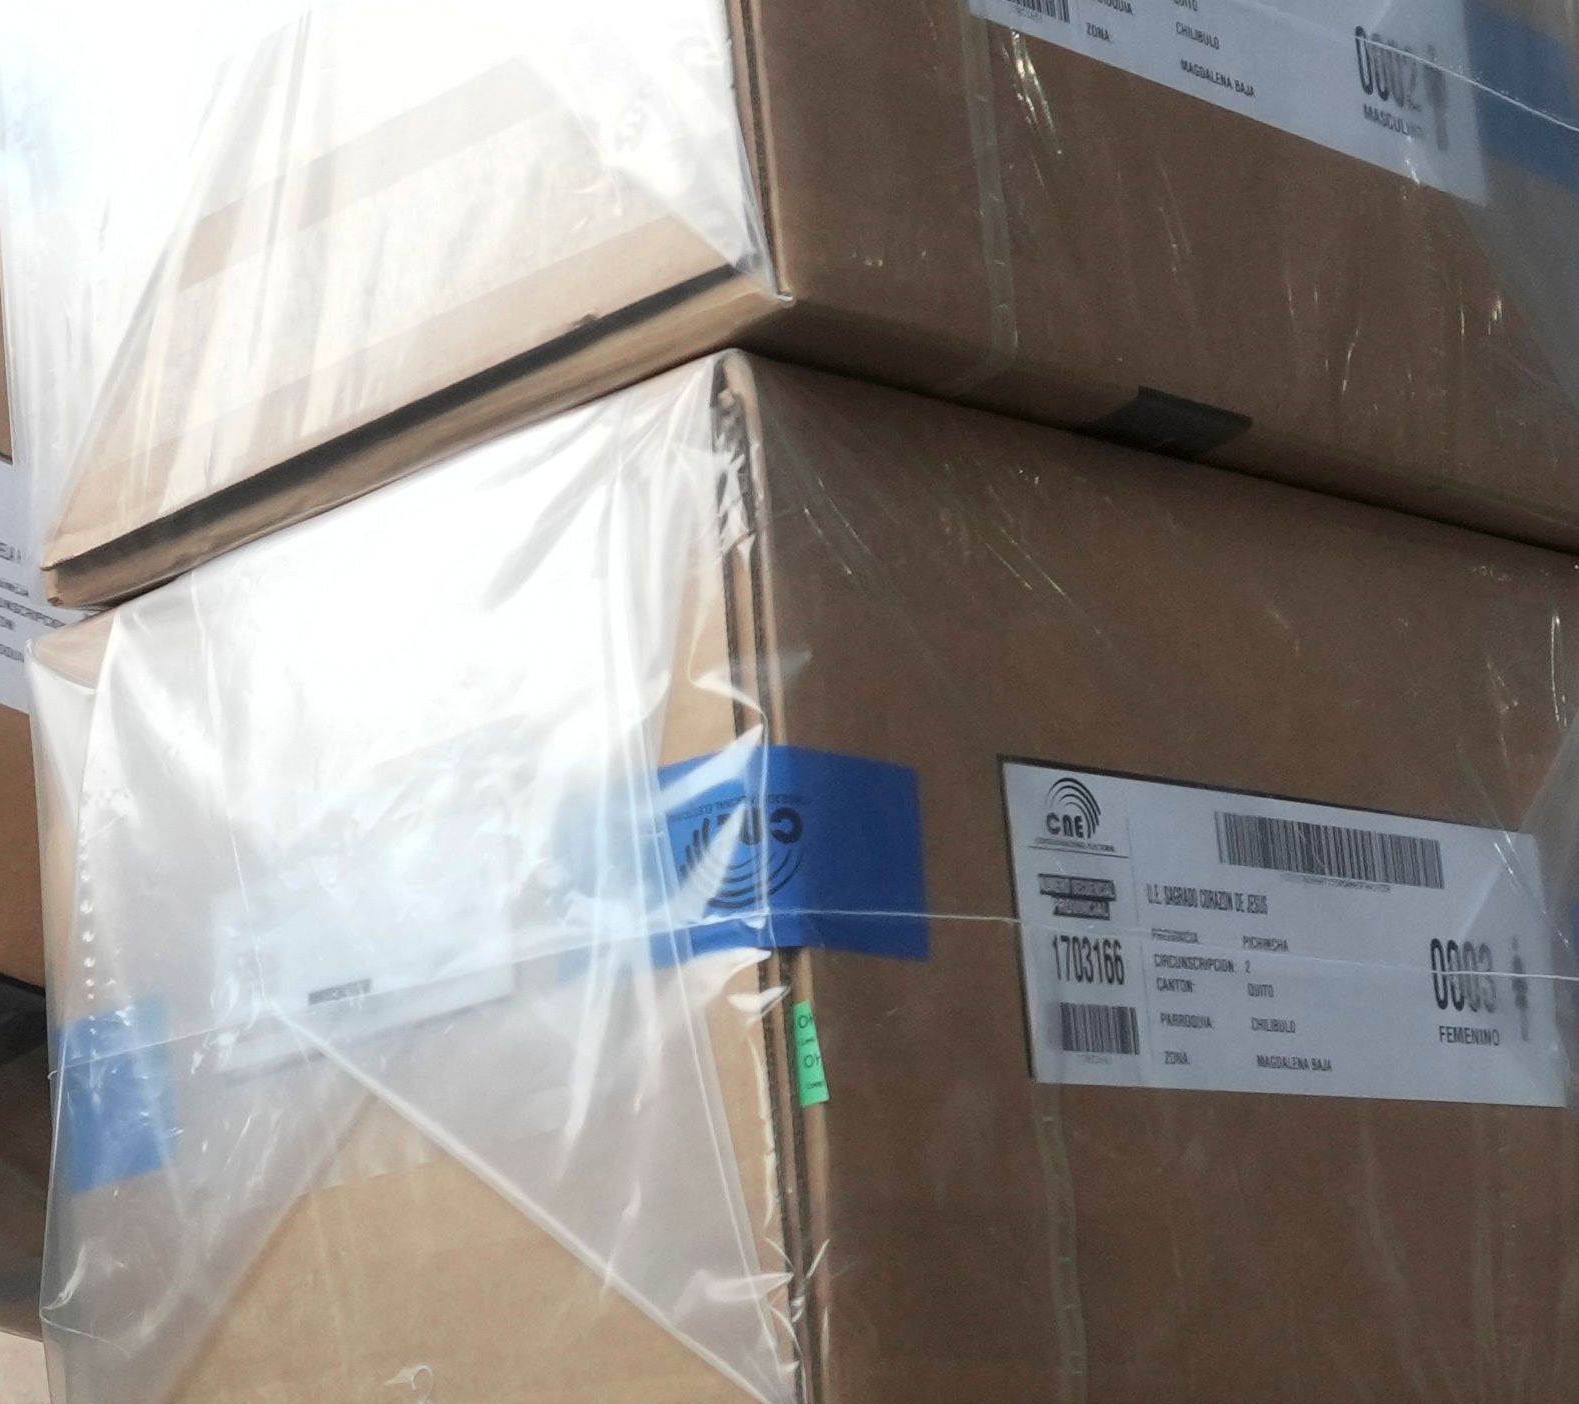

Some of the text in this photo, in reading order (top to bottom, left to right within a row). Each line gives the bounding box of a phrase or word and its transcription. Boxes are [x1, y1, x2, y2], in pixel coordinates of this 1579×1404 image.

[1046, 812, 1084, 838] CNE
[1052, 935, 1125, 985] 1703166
[1438, 1025, 1500, 1047] FEMENINO
